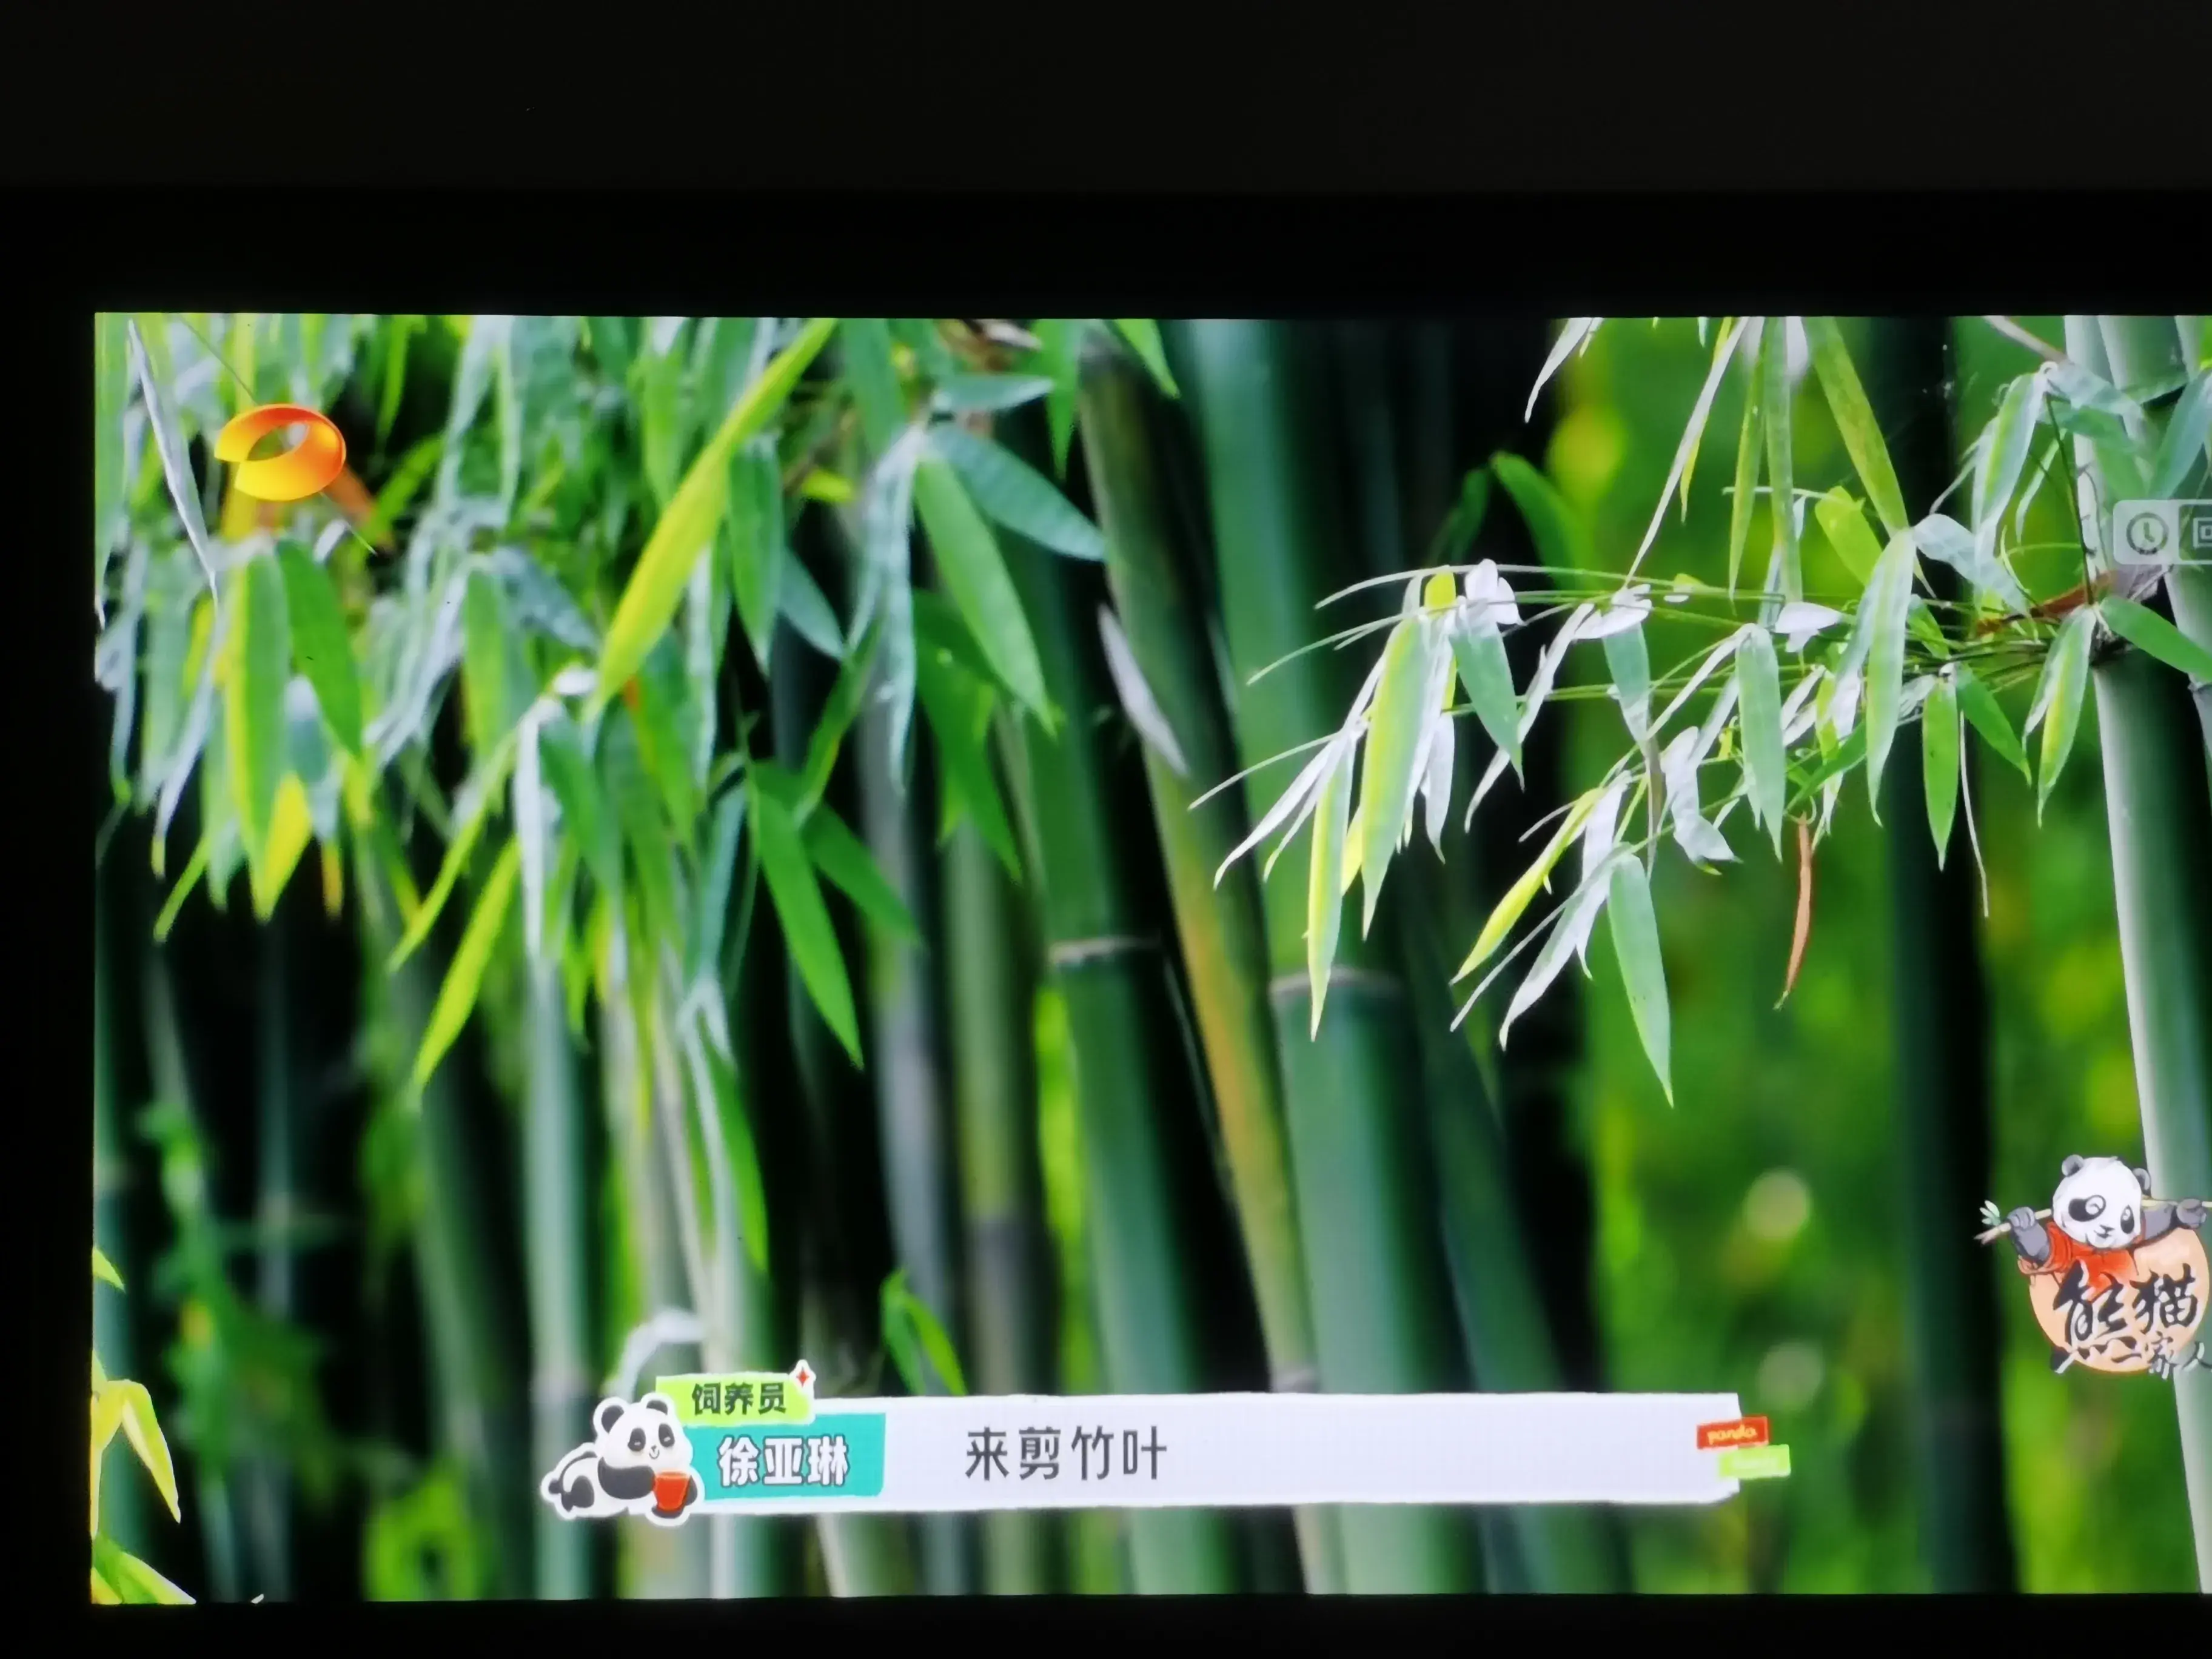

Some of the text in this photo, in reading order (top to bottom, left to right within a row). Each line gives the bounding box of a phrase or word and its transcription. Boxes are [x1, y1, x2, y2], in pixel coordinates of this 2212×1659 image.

[691, 1381, 787, 1416] 饲养员
[717, 1435, 850, 1487] 徐亚琳
[965, 1426, 1168, 1481] 来剪竹叶
